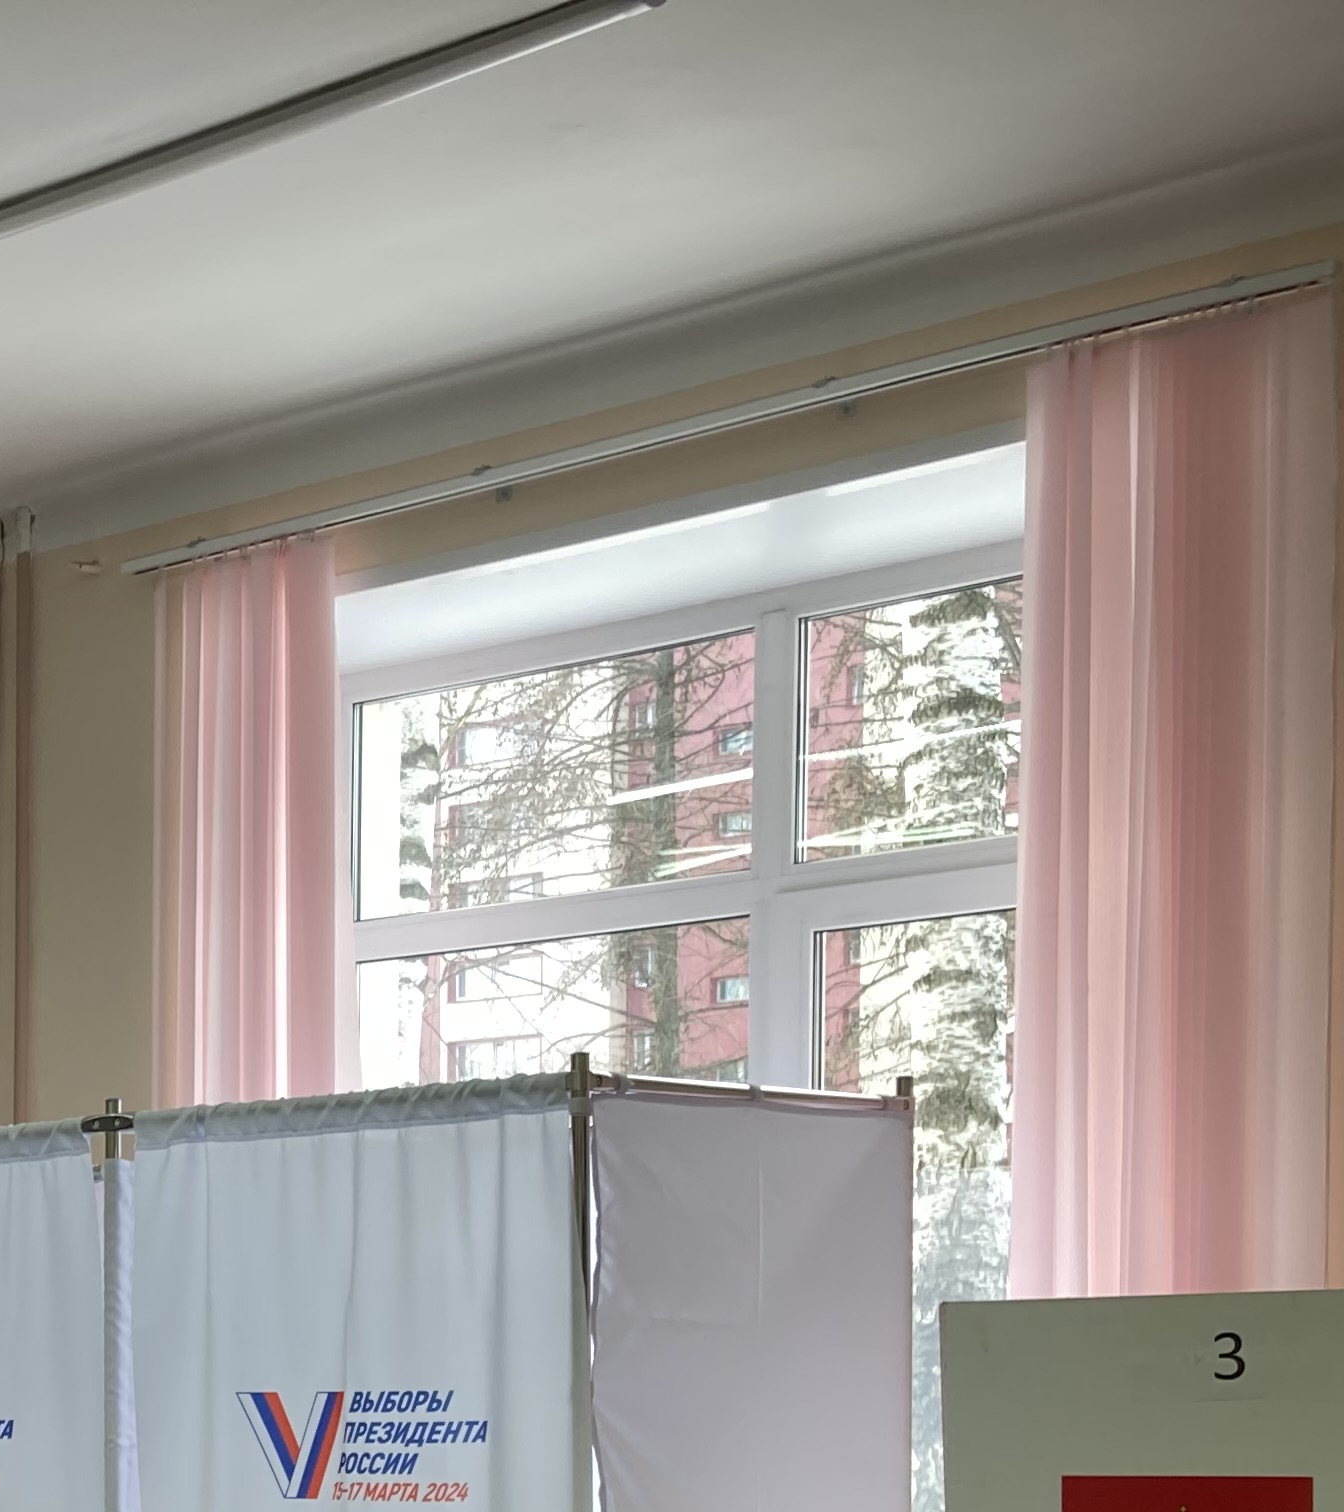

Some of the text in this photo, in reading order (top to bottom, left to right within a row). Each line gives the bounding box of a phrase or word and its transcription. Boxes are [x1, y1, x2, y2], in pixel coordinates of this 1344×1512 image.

[1213, 1332, 1246, 1381] 3
[348, 1390, 455, 1413] ВЫБОРЫ
[343, 1420, 488, 1447] ПРЕЗИДЕНТА
[338, 1452, 419, 1475] РОССИИ
[364, 1482, 420, 1502] МАРТА
[421, 1482, 470, 1503] 2024
